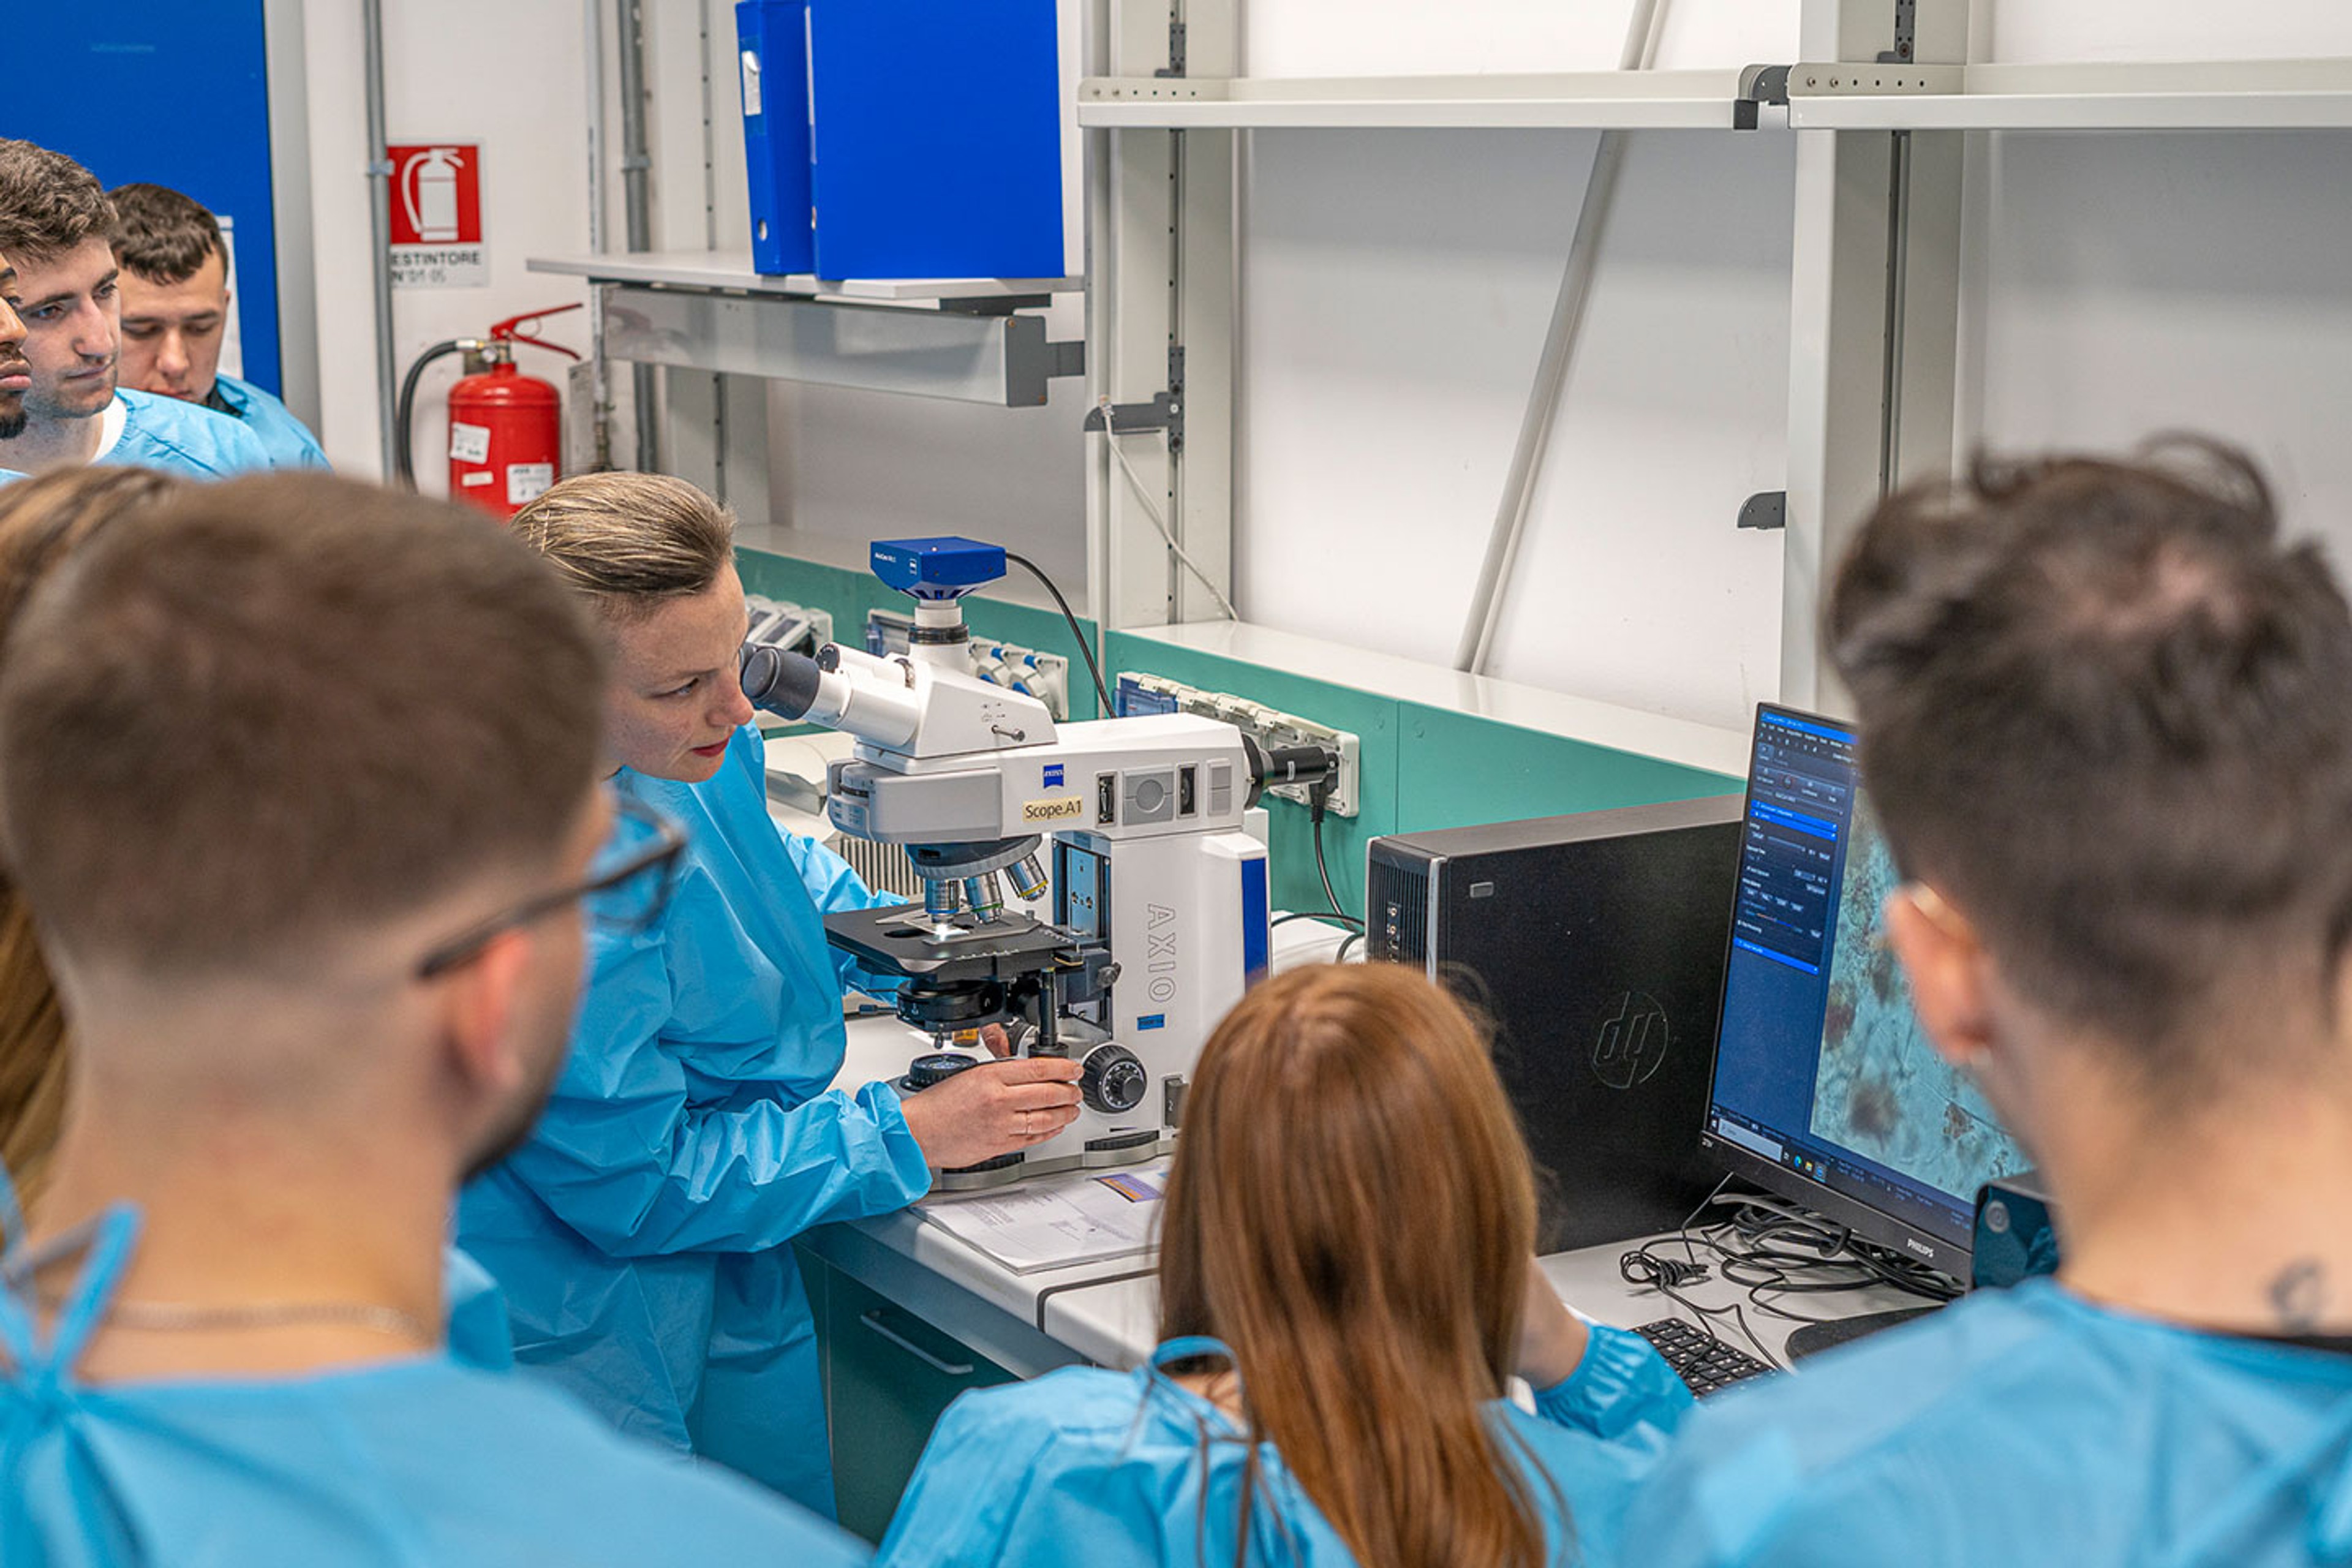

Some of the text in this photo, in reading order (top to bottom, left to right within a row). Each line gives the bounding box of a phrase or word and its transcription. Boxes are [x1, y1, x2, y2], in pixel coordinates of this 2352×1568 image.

[391, 251, 481, 265] ESTINTORE
[1025, 800, 1081, 820] Scope.A1
[1148, 903, 1177, 1003] AXIO
[1907, 1237, 1934, 1258] PHILIPS
